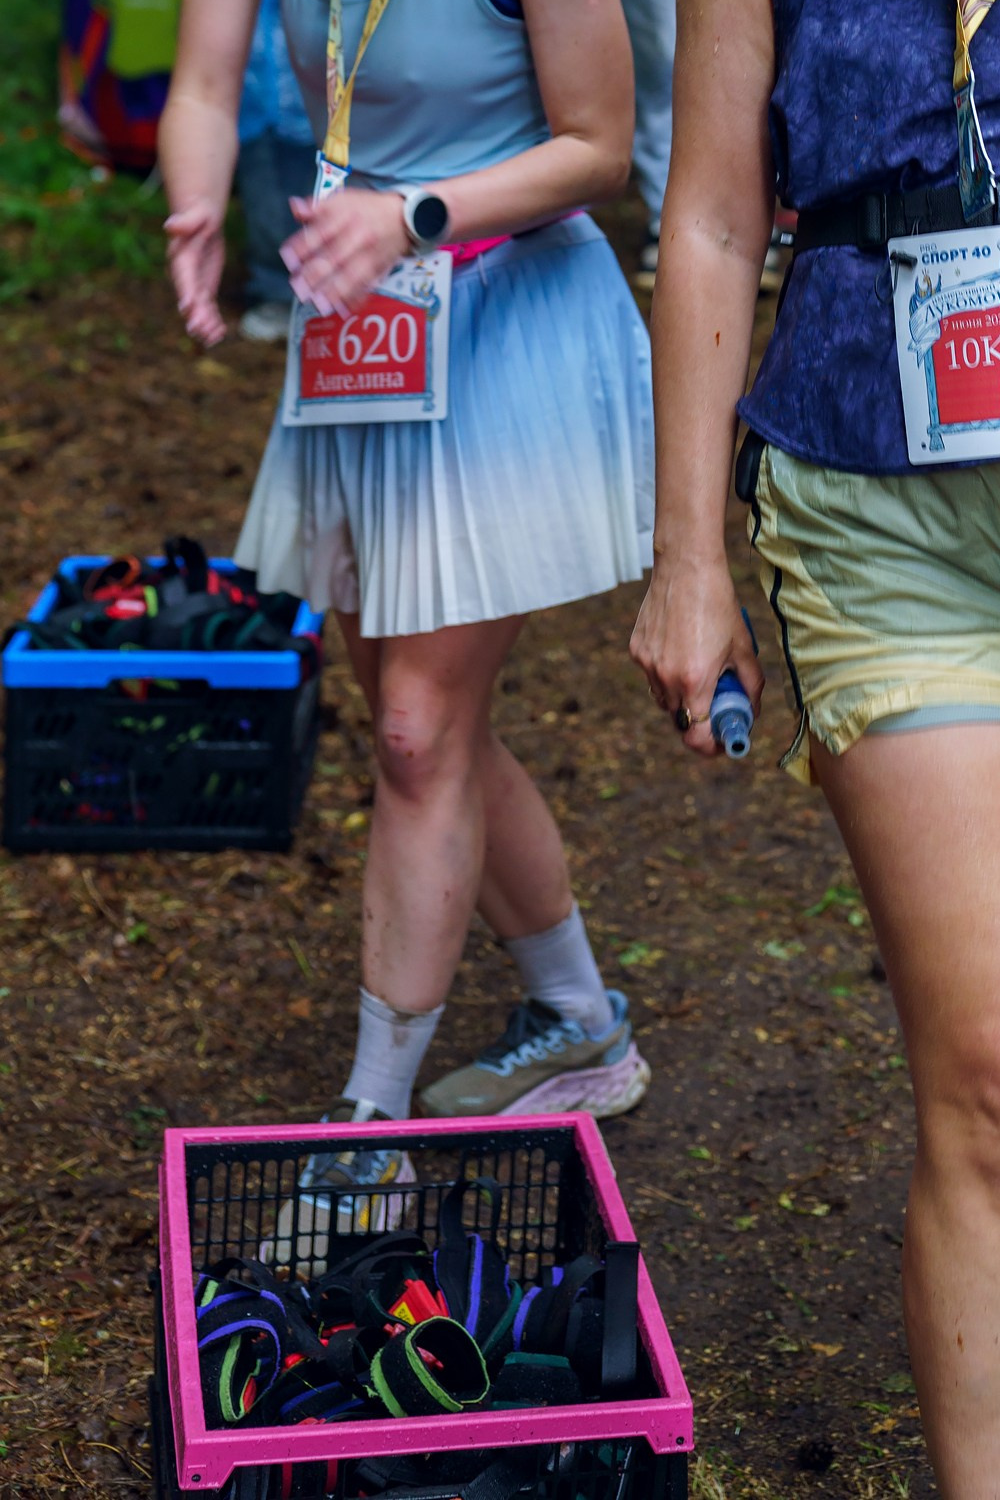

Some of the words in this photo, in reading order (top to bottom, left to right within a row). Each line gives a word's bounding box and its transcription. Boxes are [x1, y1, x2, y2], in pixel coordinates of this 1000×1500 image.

[921, 248, 968, 266] СПОРТ
[971, 245, 992, 259] 40
[951, 317, 983, 331] июня
[338, 313, 418, 366] 620
